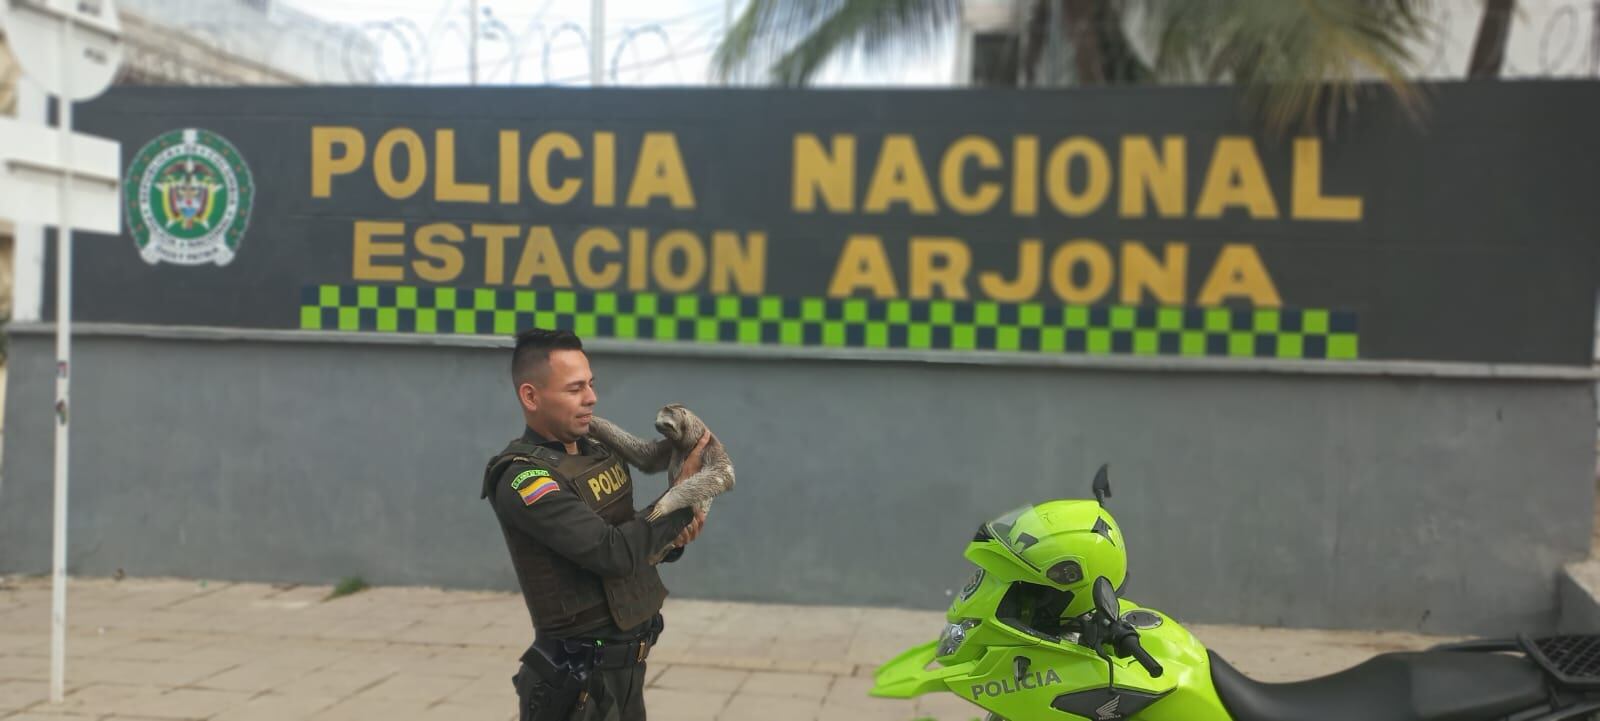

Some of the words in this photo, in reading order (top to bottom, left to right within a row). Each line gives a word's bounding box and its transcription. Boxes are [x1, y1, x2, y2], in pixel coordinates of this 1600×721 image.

[311, 126, 696, 208] POLICIA
[792, 133, 1363, 221] NACIONAL
[352, 220, 767, 295] ESTACION
[828, 234, 1282, 308] ARJONA
[971, 669, 1062, 701] POLICIA
